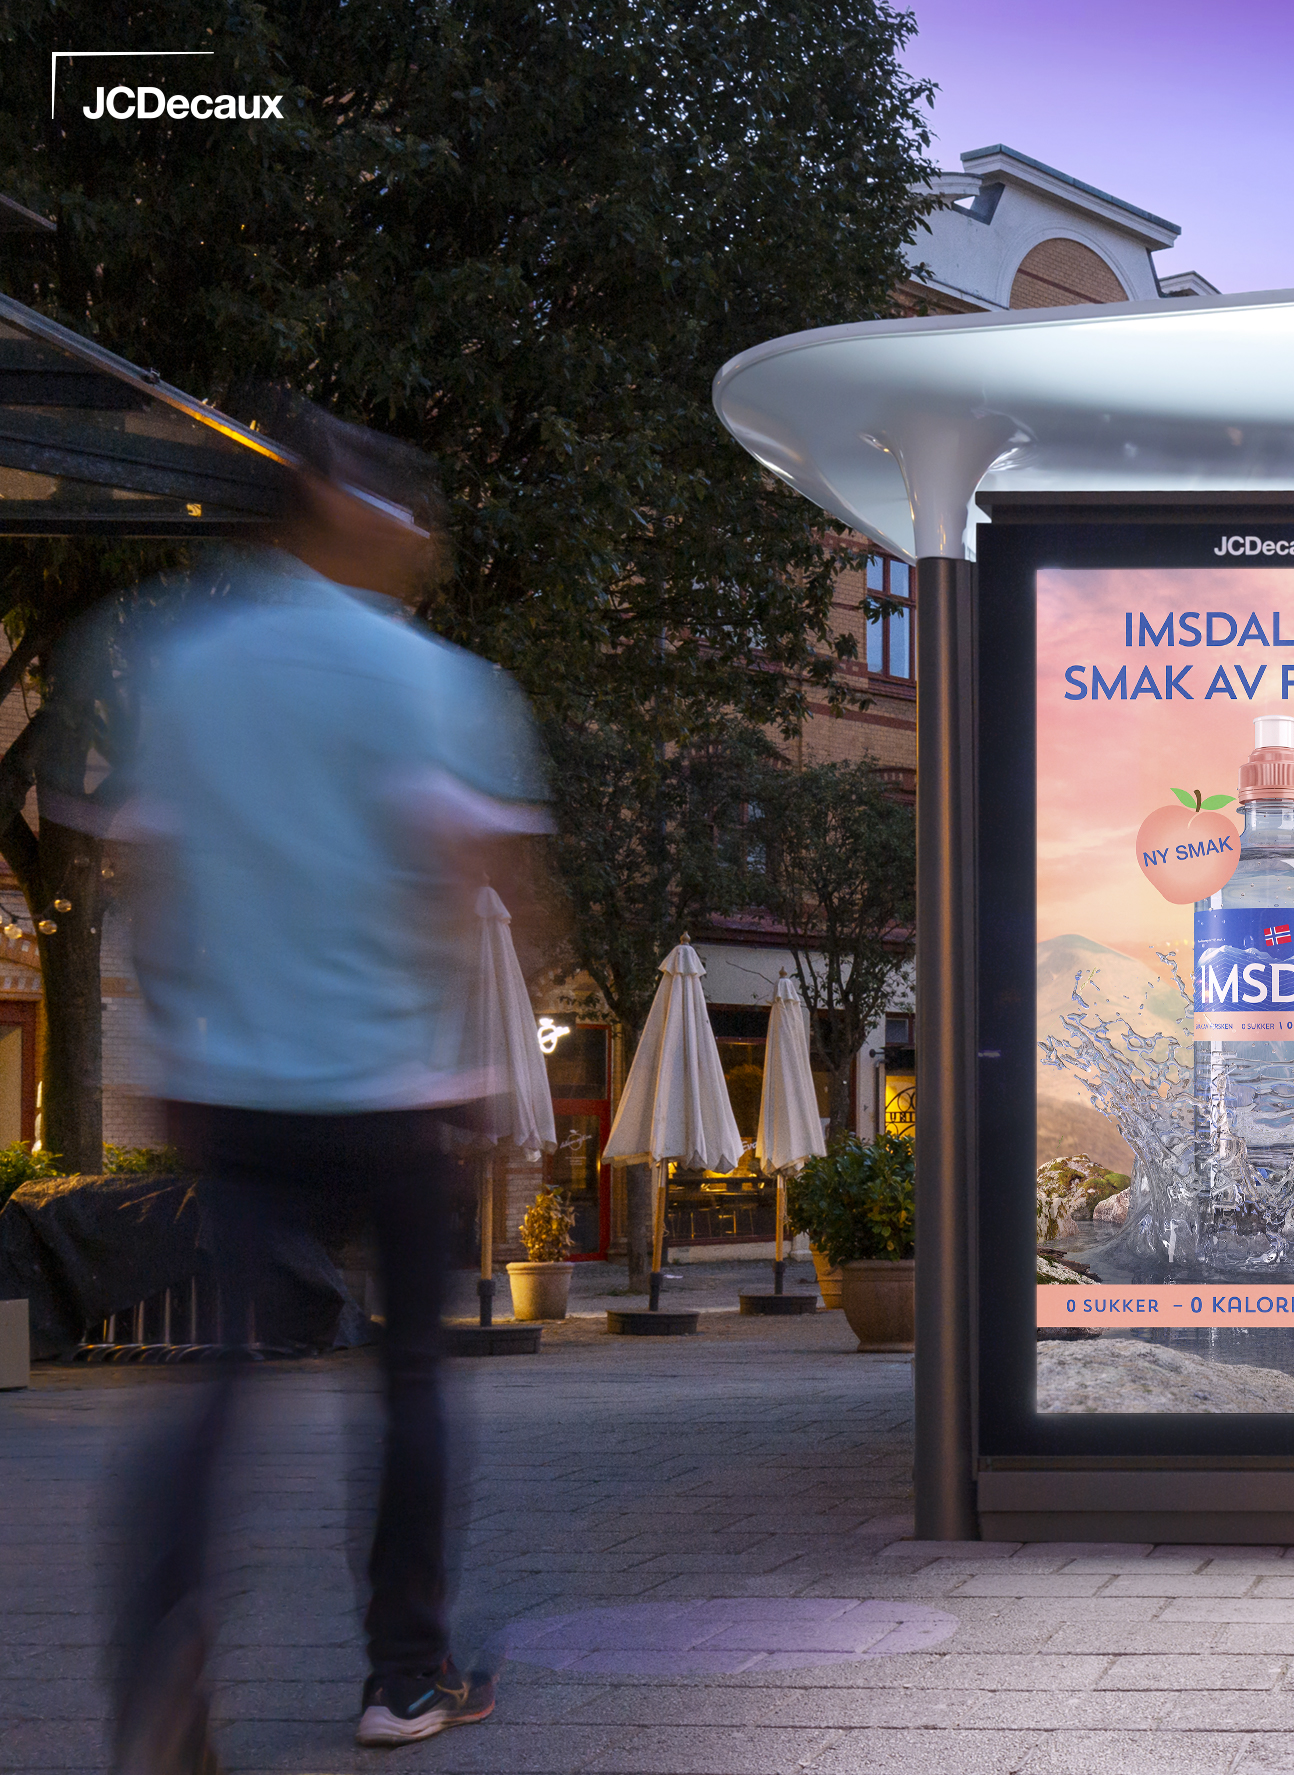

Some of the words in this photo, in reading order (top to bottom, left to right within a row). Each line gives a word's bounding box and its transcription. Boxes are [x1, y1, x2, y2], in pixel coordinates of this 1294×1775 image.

[1064, 664, 1194, 700] SMAK
[1204, 664, 1268, 700] AV
[1142, 847, 1170, 868] NY
[1175, 835, 1234, 861] SMAK
[1286, 1021, 1293, 1030] 0
[1066, 1299, 1076, 1313] 0
[1083, 1299, 1159, 1313] SUKKER
[1190, 1296, 1203, 1313] 0
